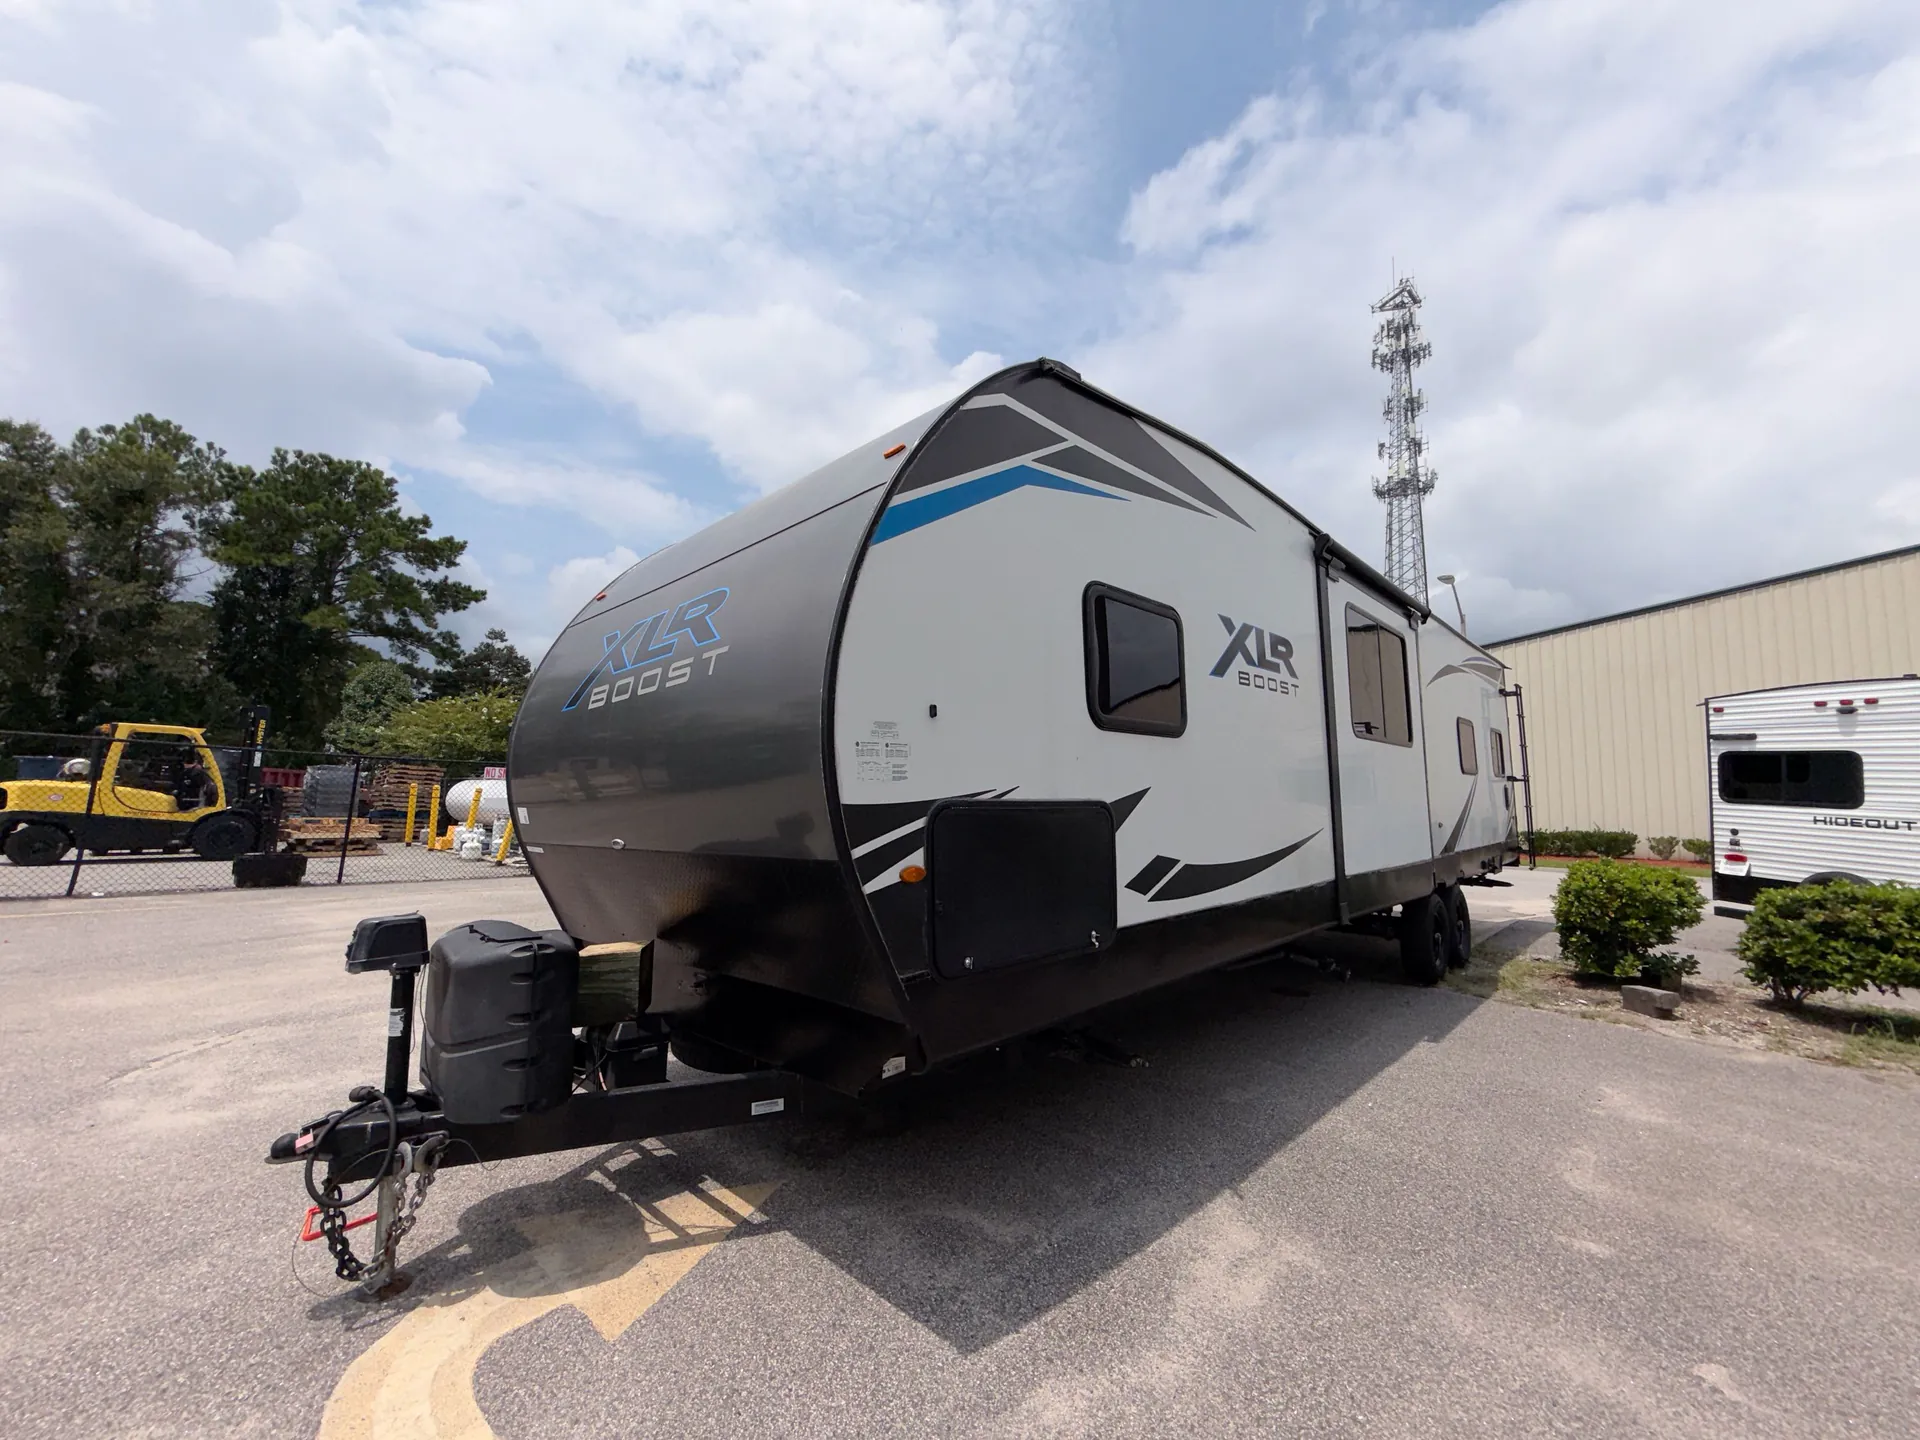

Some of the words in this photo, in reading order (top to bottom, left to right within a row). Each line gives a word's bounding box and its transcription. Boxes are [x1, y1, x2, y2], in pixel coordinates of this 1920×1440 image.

[561, 587, 730, 712] XLR
[1209, 613, 1299, 680] XLR
[588, 645, 730, 710] BOOST
[1238, 670, 1299, 698] BOOST
[256, 719, 267, 745] HYSTER
[485, 767, 496, 778] NO
[1813, 816, 1917, 831] HIDEOUT
